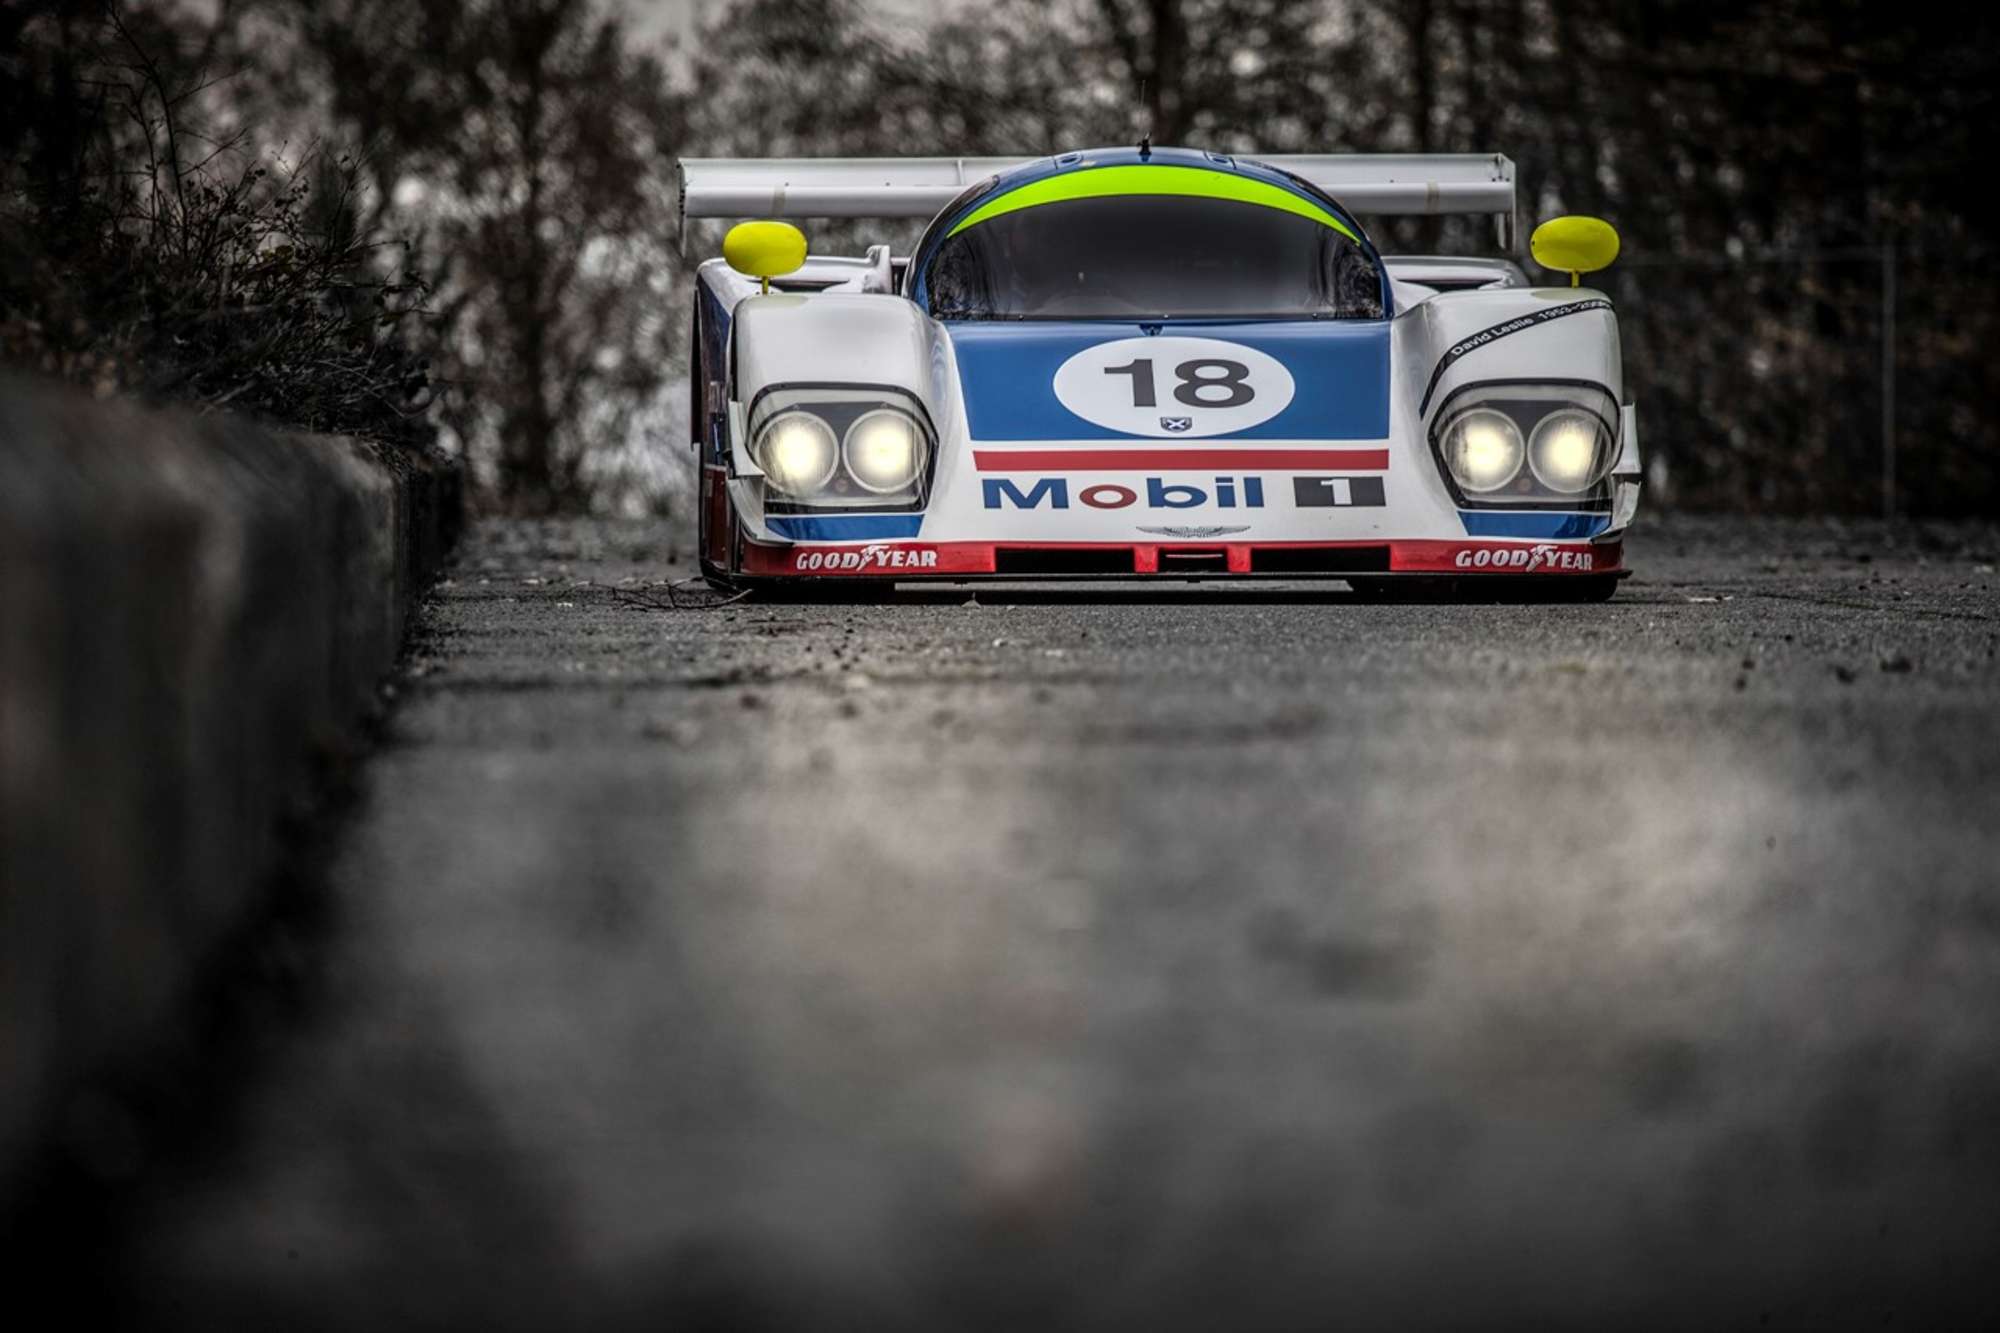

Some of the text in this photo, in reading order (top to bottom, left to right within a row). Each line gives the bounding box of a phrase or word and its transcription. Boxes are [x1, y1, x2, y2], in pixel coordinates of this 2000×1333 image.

[1450, 332, 1493, 355] David
[1491, 318, 1534, 336] Leslie
[1104, 358, 1256, 408] 18
[982, 476, 1265, 509] Mobil
